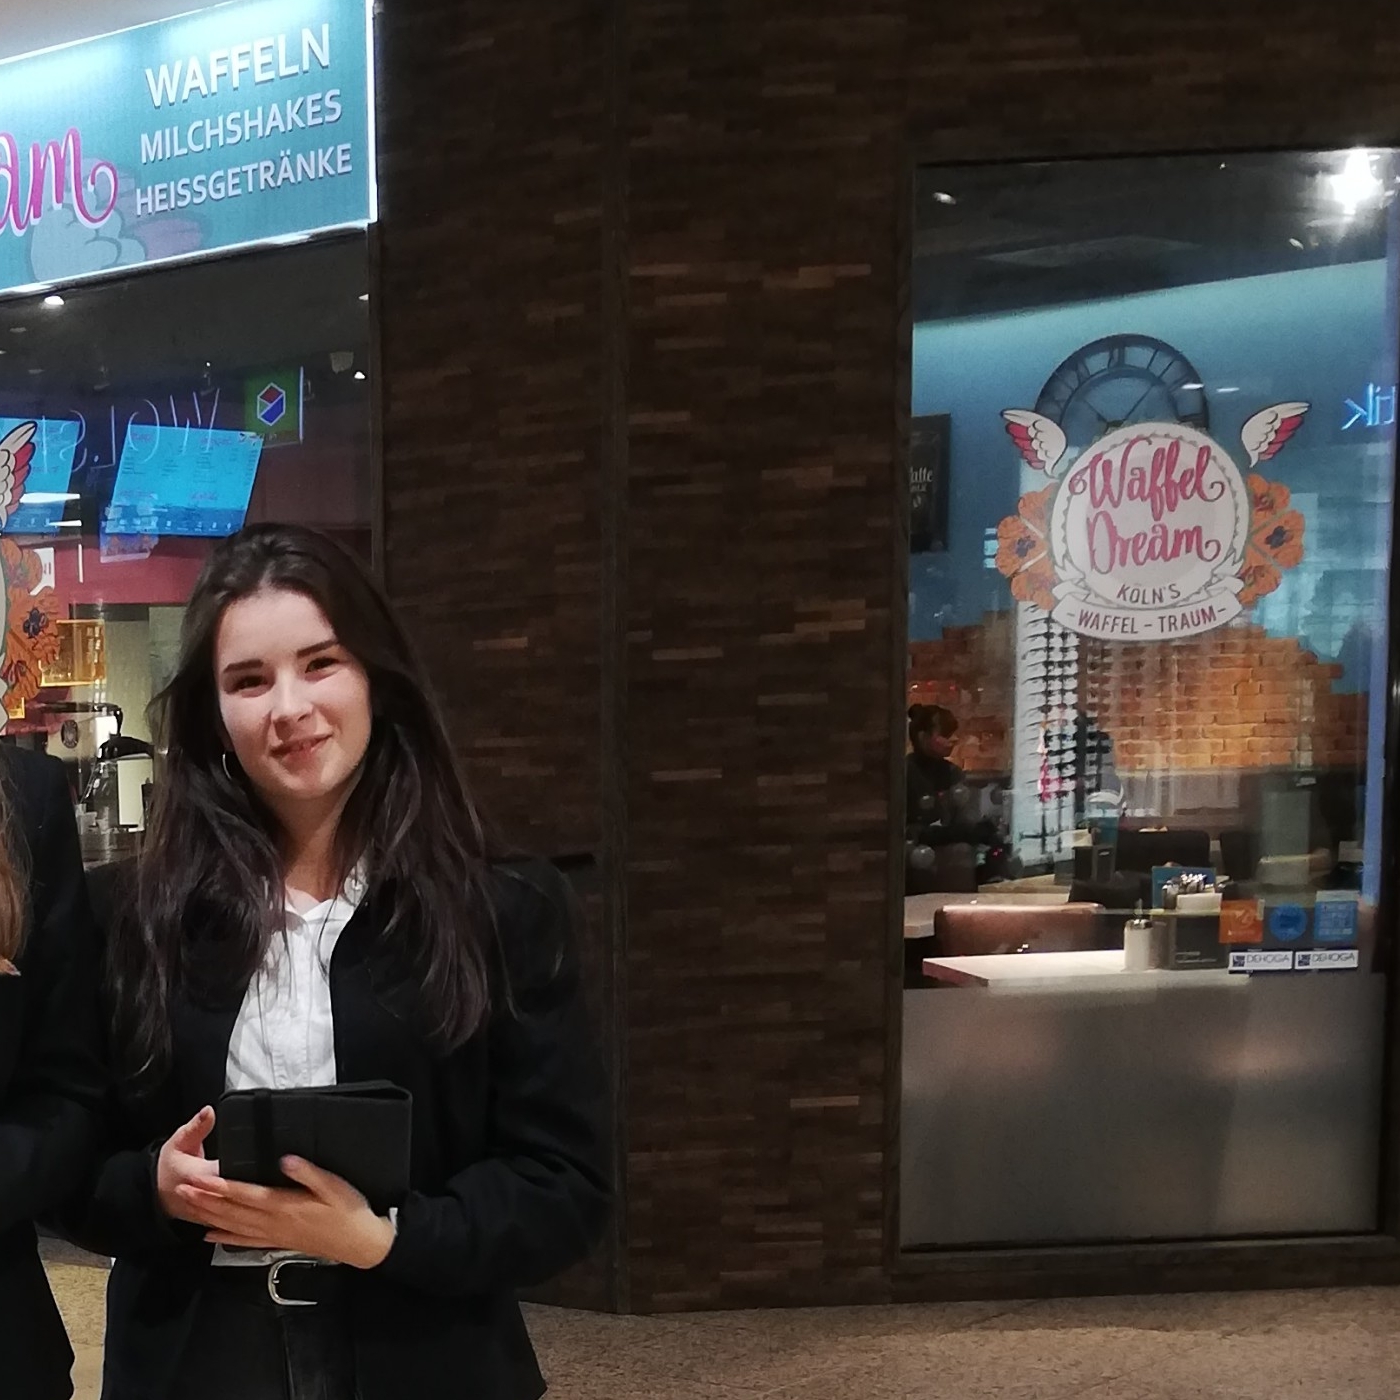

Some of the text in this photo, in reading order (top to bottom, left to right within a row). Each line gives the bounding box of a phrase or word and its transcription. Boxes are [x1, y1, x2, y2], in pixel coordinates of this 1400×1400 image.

[146, 24, 332, 109] WAFFELN
[141, 89, 343, 165] MILCHSHAKES
[136, 142, 353, 217] HEISSGETRÄNKE
[1068, 436, 1225, 521] Waffel
[1086, 510, 1221, 574] Dream
[1078, 609, 1139, 634] WAFFEL
[1158, 605, 1217, 634] TRAUM
